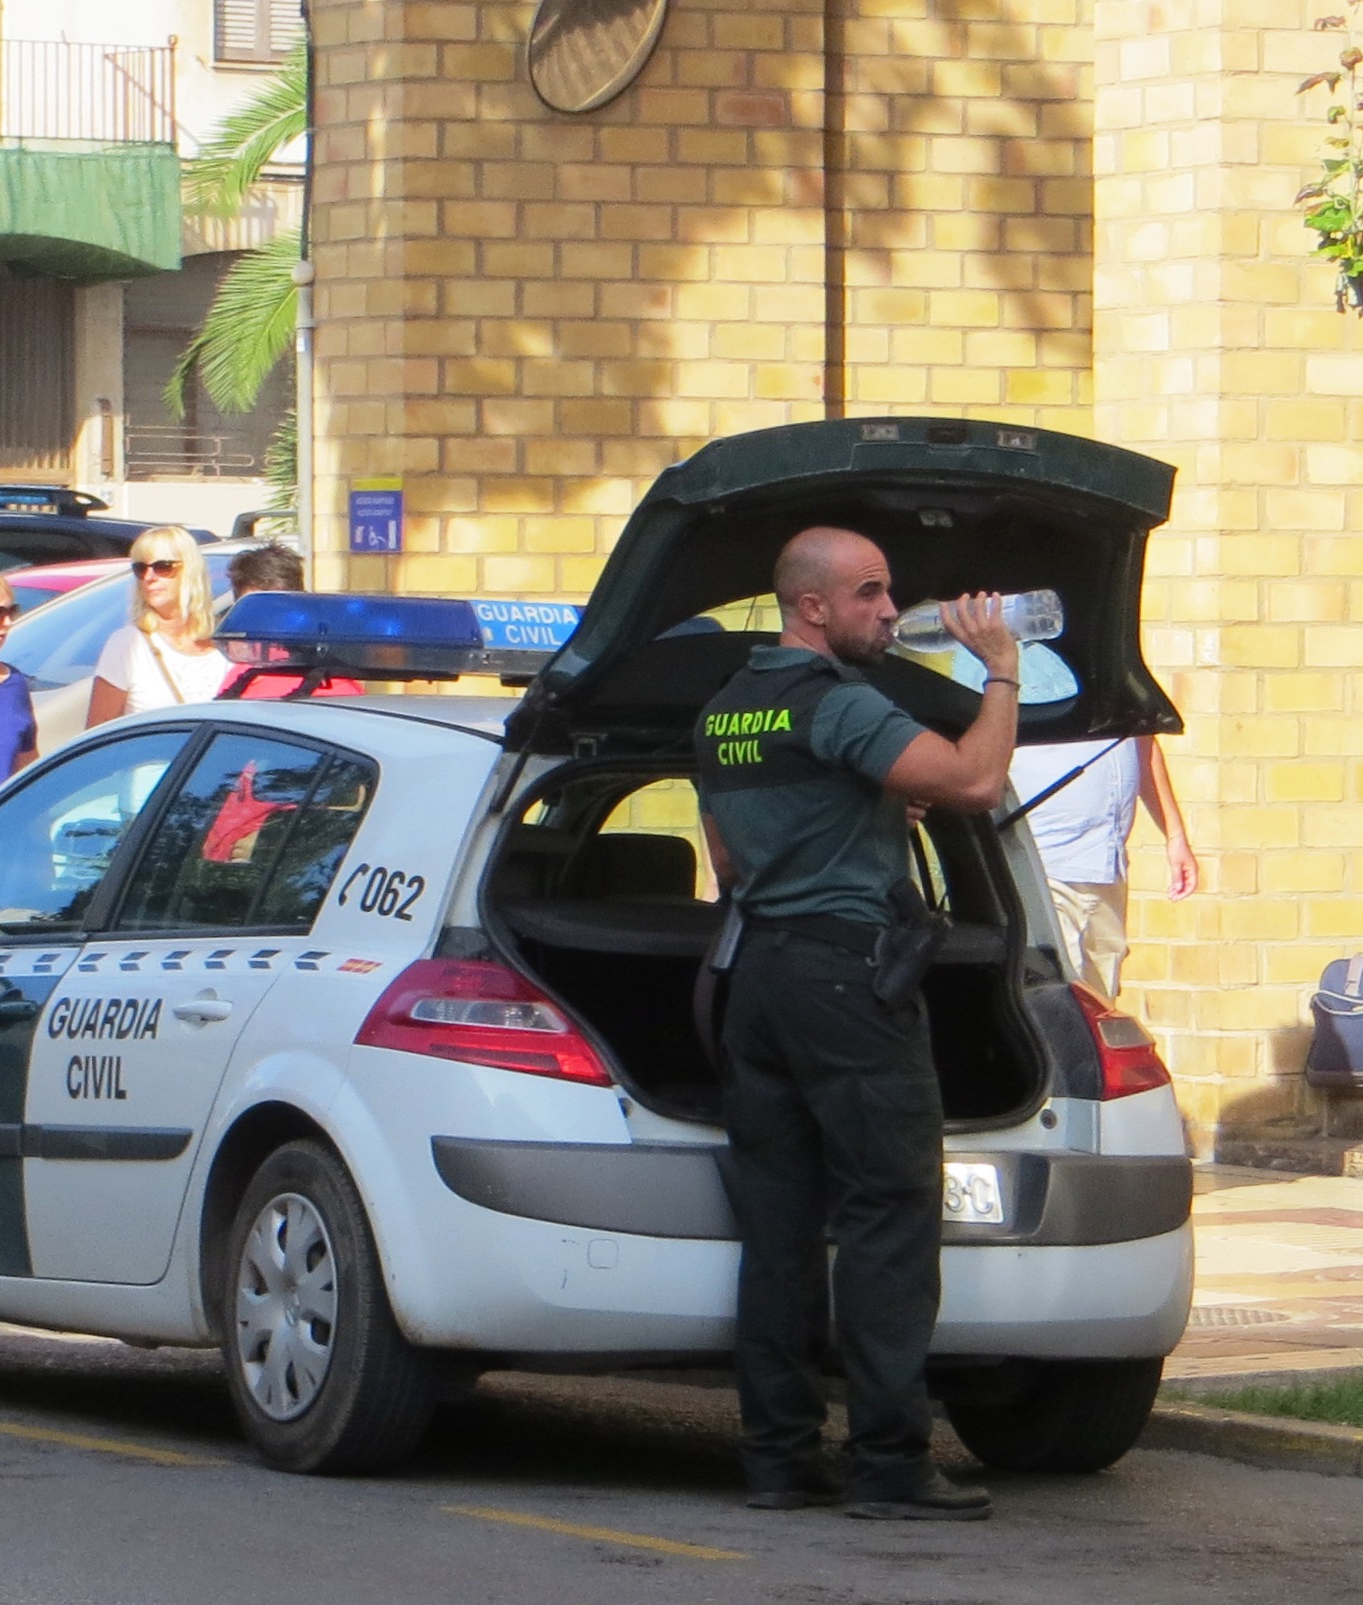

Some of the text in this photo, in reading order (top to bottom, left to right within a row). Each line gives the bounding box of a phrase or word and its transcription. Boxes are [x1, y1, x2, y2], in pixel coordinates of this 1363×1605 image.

[476, 603, 579, 625] GUARDIA
[505, 624, 564, 646] CIVIL
[705, 709, 791, 737] GUARDIA
[718, 740, 763, 766] CIVIL
[360, 866, 425, 922] 062
[48, 997, 164, 1039] GUARDIA
[67, 1055, 127, 1100] CIVIL
